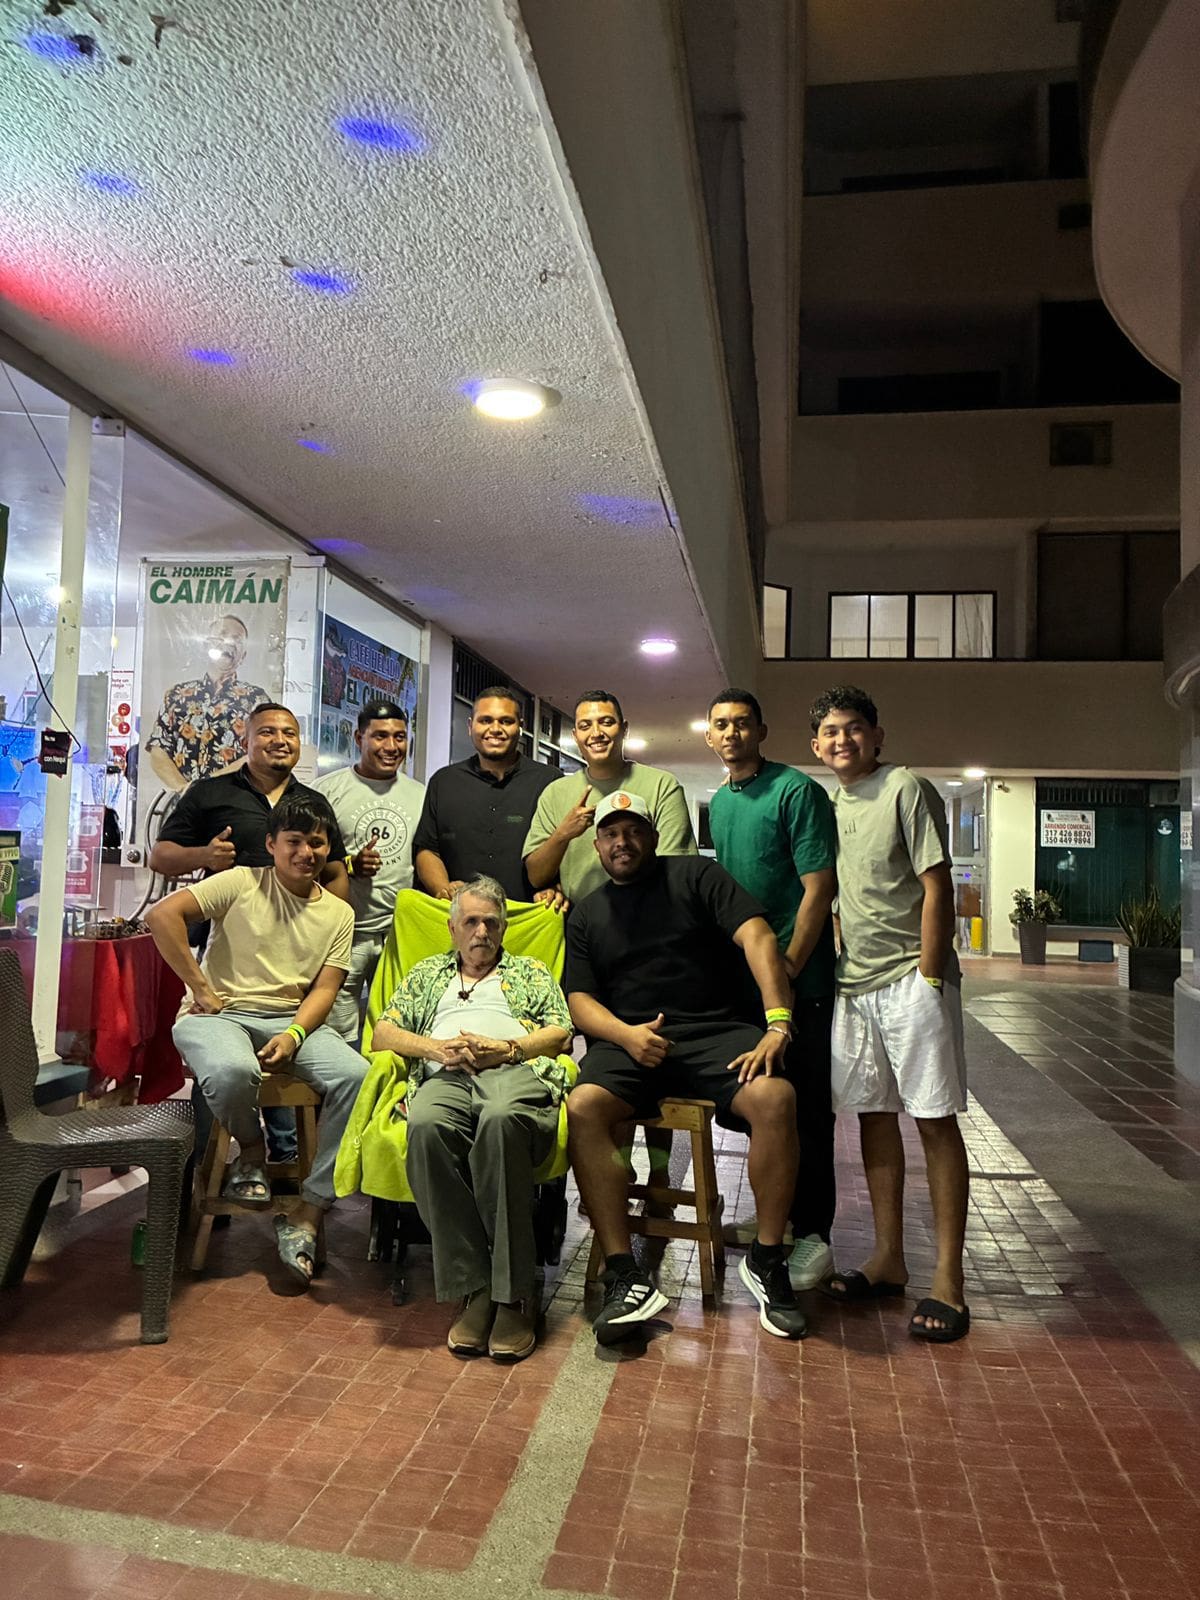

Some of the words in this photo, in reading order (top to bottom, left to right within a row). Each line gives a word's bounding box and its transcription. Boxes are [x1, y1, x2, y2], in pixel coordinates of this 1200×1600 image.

[151, 566, 167, 577] EL
[172, 566, 234, 577] HOMBRE
[150, 572, 282, 604] CAIMÁN
[358, 809, 406, 831] NINETEEN
[371, 826, 390, 840] 86
